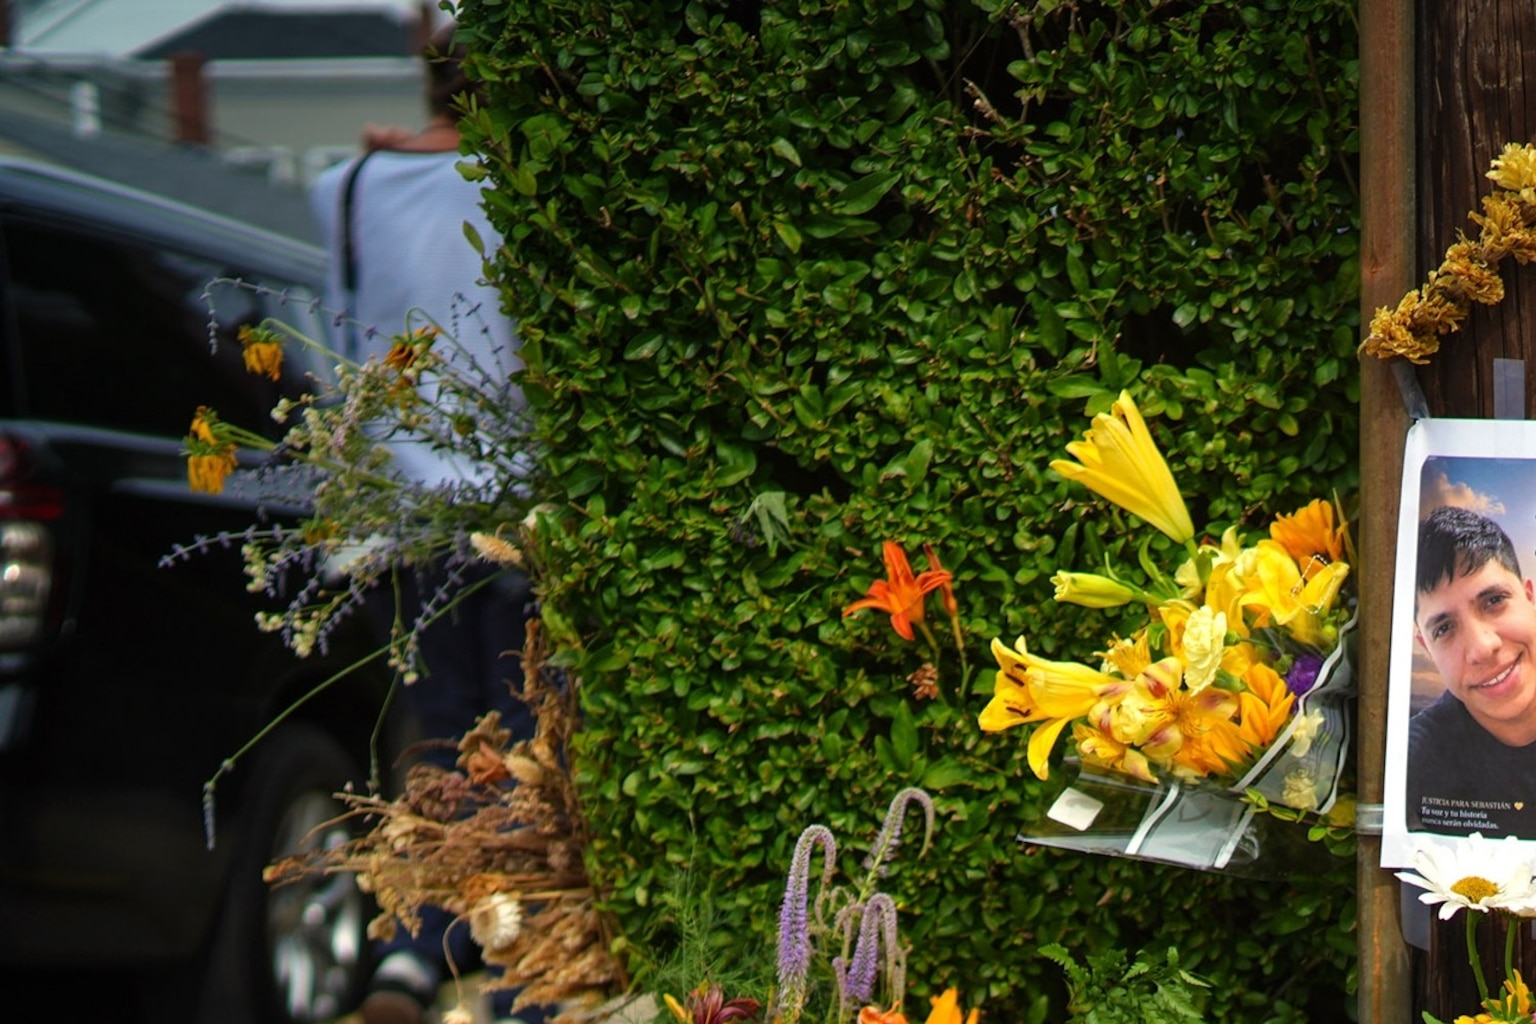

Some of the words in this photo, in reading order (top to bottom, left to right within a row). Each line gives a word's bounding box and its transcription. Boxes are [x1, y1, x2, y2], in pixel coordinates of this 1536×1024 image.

[1421, 796, 1450, 806] JUSTICIA
[1451, 799, 1469, 808] PARA
[1421, 806, 1430, 815] Tu
[1459, 809, 1488, 819] historia
